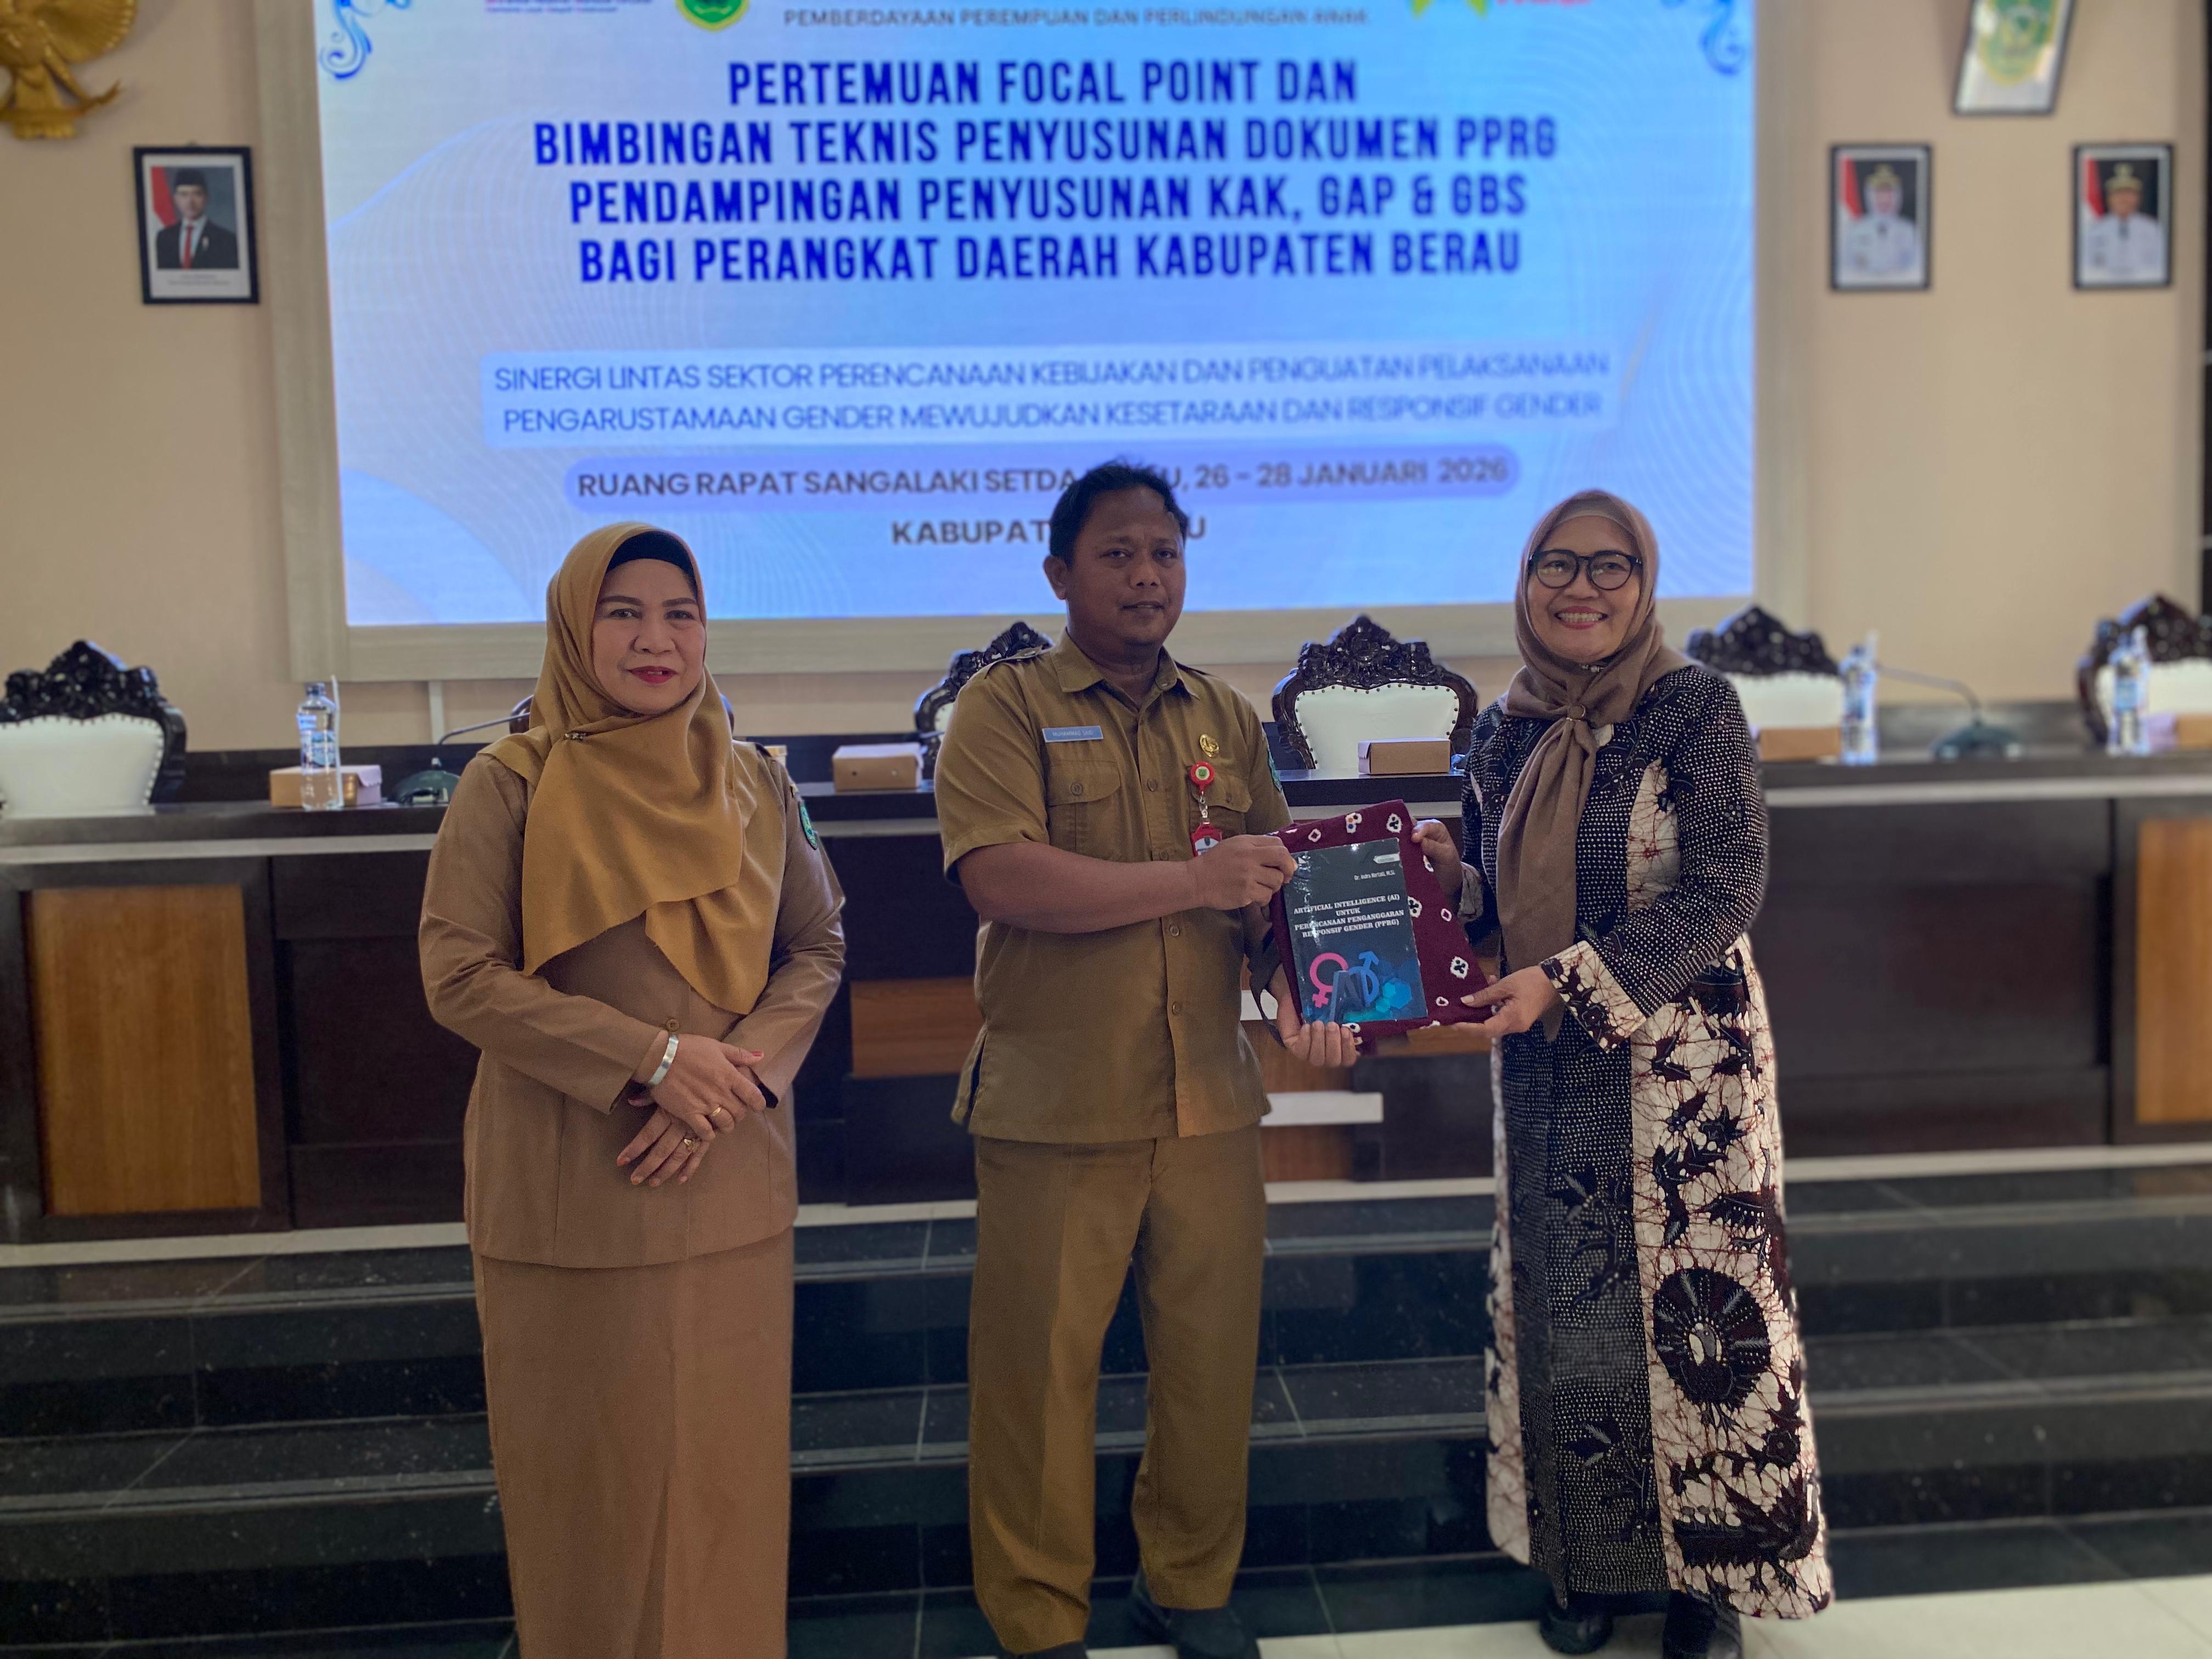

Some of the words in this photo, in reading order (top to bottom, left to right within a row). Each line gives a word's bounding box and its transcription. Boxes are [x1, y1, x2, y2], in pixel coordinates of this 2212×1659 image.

[784, 9, 953, 26] PEMBERDAYAAN
[960, 9, 1087, 26] PEREMPUAN
[1097, 9, 1137, 25] DAN
[729, 61, 979, 105] PERTEMUAN
[999, 61, 1125, 104] FOCAL
[1143, 61, 1259, 104] POINT
[1278, 60, 1356, 103] DAN
[534, 121, 773, 165] BIMBINGAN
[789, 120, 939, 164] TEKNIS
[956, 119, 1227, 163] PENYUSUNAN
[1244, 117, 1439, 161] DOKUMEN
[1456, 116, 1557, 160] PPRG
[570, 179, 901, 223] PENDAMPINGAN
[920, 177, 1189, 221] PENYUSUNAN
[1208, 176, 1302, 223] KAK,
[1319, 175, 1395, 217] GAP
[1412, 175, 1435, 217] &
[1451, 173, 1527, 216] GBS
[579, 239, 676, 283] BAGI
[695, 237, 938, 281] PERANGKAT
[957, 235, 1118, 279] DAERAH
[1136, 232, 1374, 277] KABUPATEN
[1391, 230, 1521, 274] BERAU
[495, 366, 601, 391] SINERGI
[609, 364, 701, 389] LINTAS
[708, 364, 812, 387] SEKTOR
[820, 362, 1025, 386] PERENCANAAN
[1031, 360, 1176, 385] KEBIJAKAN
[1183, 359, 1243, 382] DAN
[1248, 356, 1414, 382] PENGUATAN
[1419, 353, 1609, 380] PELAKSANAAN
[504, 407, 775, 432] PENGARUSTAMAAN
[783, 405, 893, 430] GENDER
[900, 402, 1097, 429] MEWUJUDKAN
[1106, 400, 1277, 426] KESETARAAN
[1282, 398, 1341, 424] DAN
[1348, 394, 1485, 422] RESPONSIF
[1494, 393, 1601, 419] GENDER
[579, 473, 690, 497] RUANG
[697, 472, 797, 495] RAPAT
[804, 470, 978, 494] SANGALAKI
[984, 469, 1076, 492] SETDA
[1195, 464, 1229, 489] 26
[1256, 462, 1291, 487] 28
[1299, 460, 1427, 486] JANUARI
[1437, 458, 1508, 483] 2026
[892, 520, 1050, 545] KABUPAT
[1294, 903, 1333, 914] ARTIFICIAL
[1334, 896, 1386, 909] INTELLIGENCE
[1387, 894, 1400, 902] (AI)
[1335, 907, 1361, 916] UNTUK
[1347, 910, 1404, 923] PENGANGGARAN
[1344, 923, 1373, 932] GENDER
[1375, 918, 1400, 928] (PPRG)
